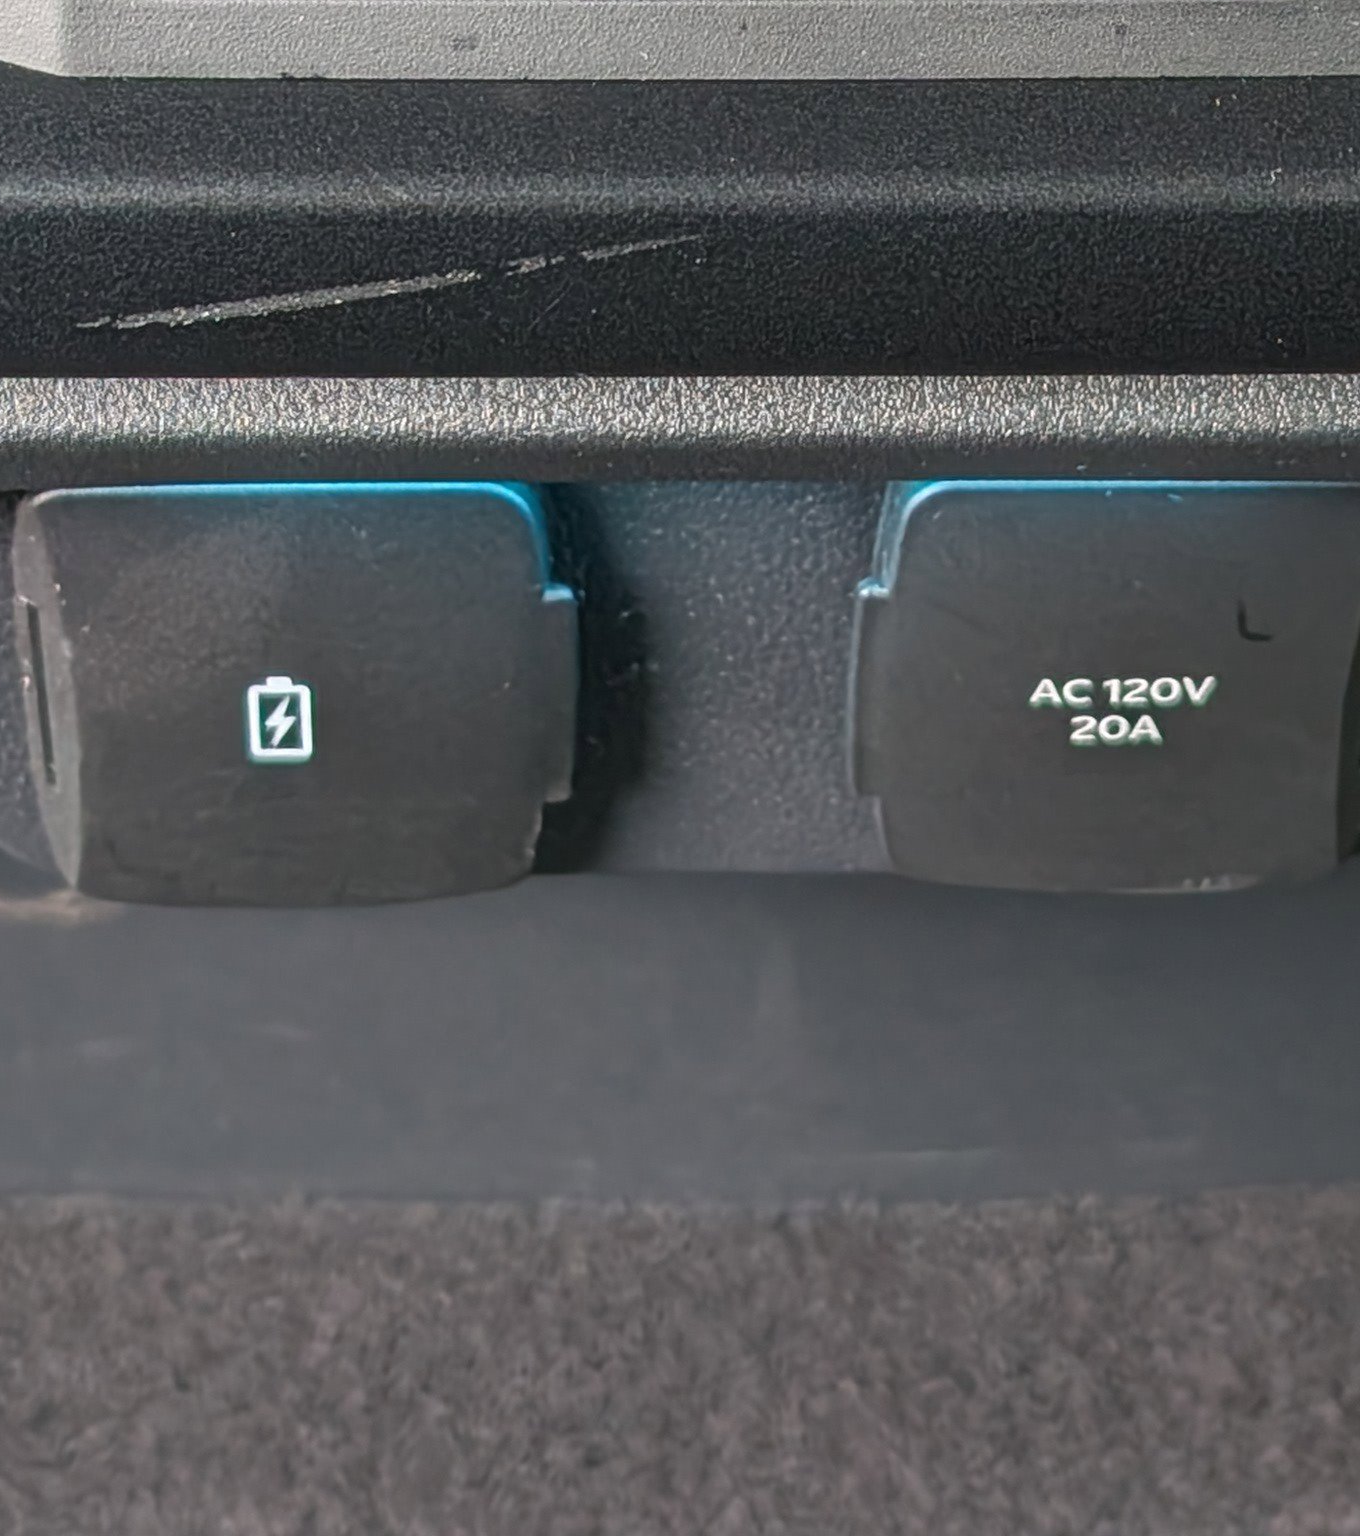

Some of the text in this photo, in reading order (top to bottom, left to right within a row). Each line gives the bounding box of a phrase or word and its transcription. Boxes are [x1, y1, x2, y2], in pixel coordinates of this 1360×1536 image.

[1029, 675, 1217, 708] AC 120V
[1069, 714, 1164, 746] 20A
